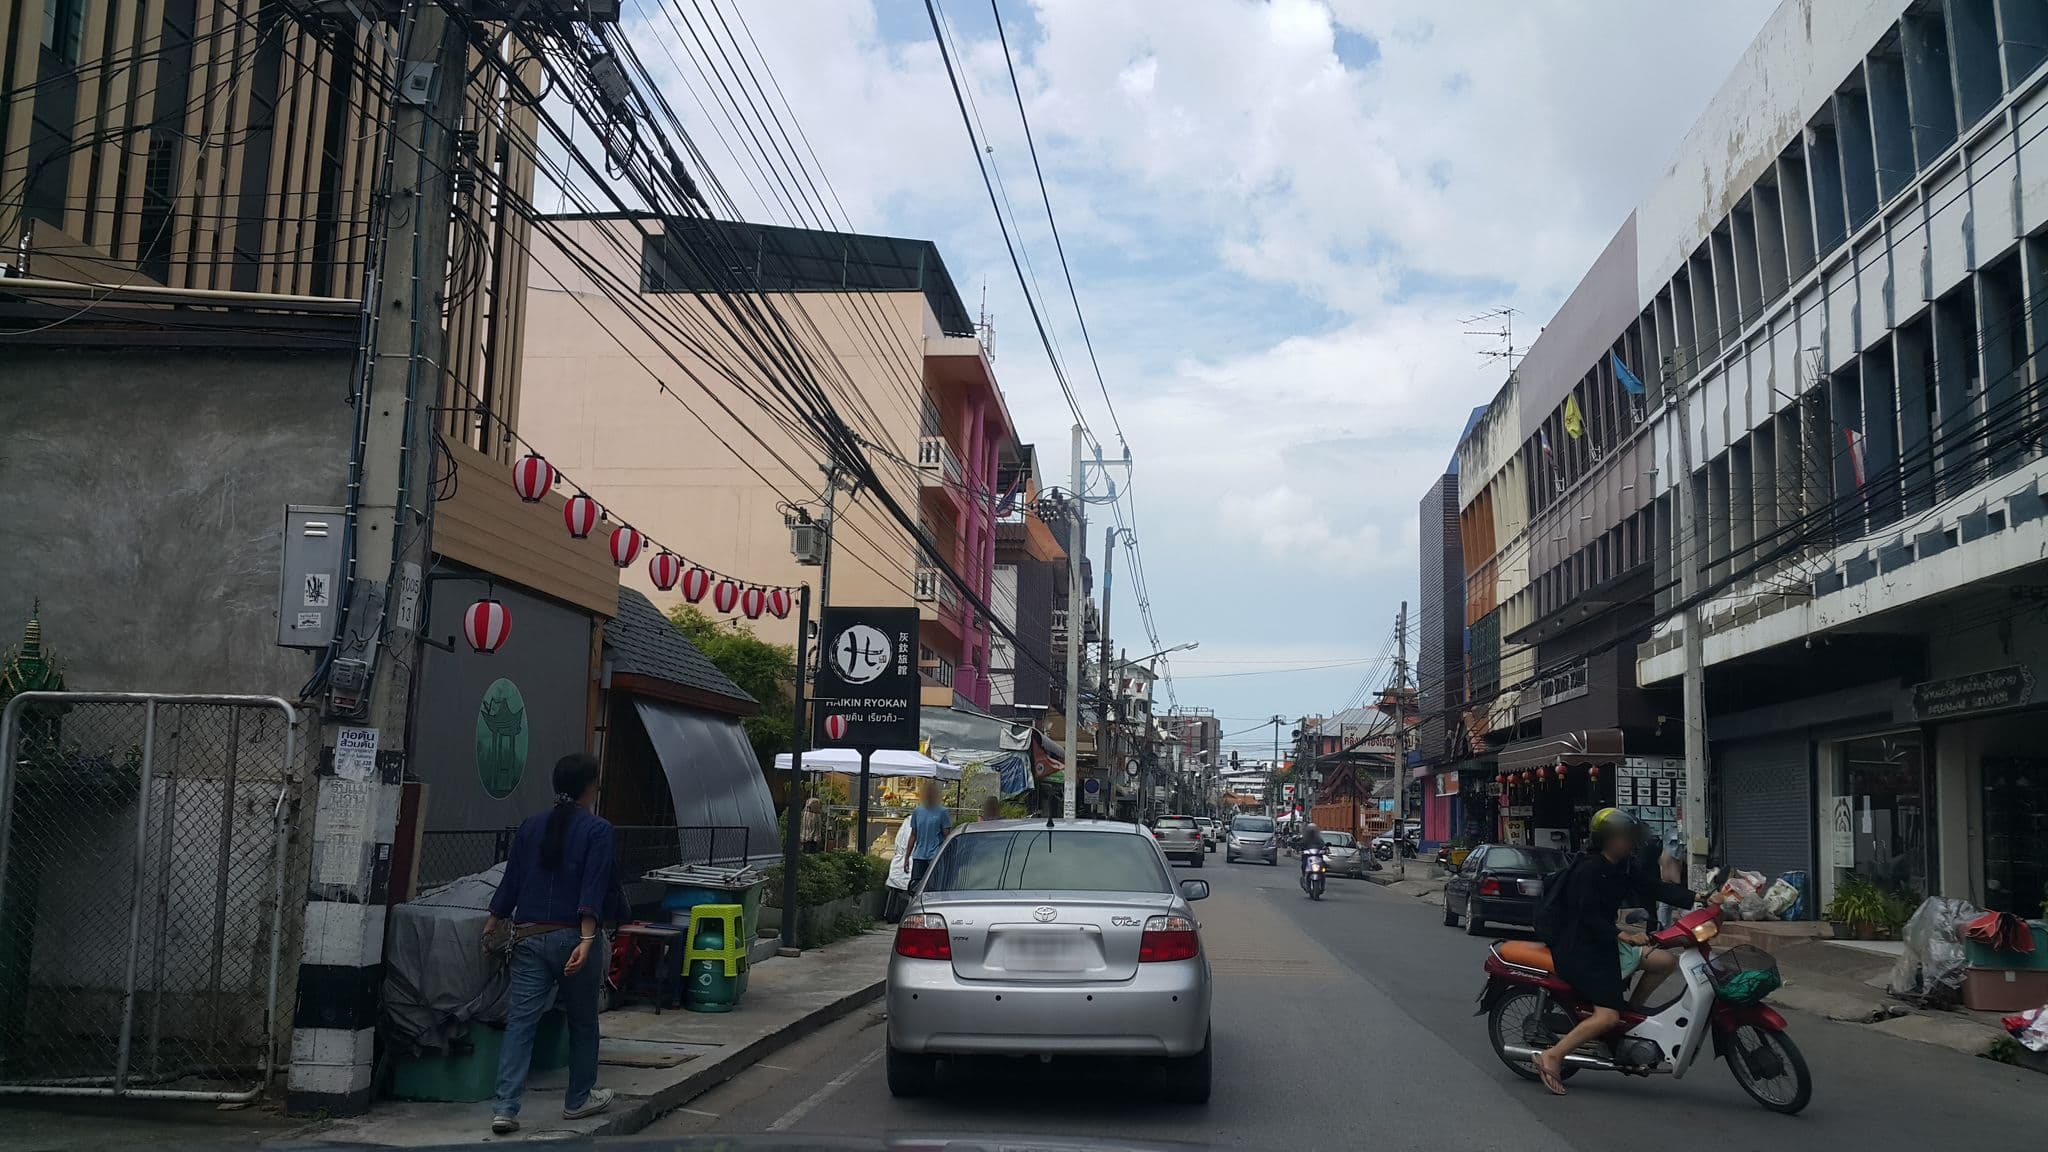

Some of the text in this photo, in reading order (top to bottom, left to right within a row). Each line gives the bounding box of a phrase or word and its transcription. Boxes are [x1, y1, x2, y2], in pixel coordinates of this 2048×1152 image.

[864, 698, 907, 708] RYOKAN
[341, 729, 375, 741] ท่อตัน
[340, 739, 375, 749] ส้วมตัน
